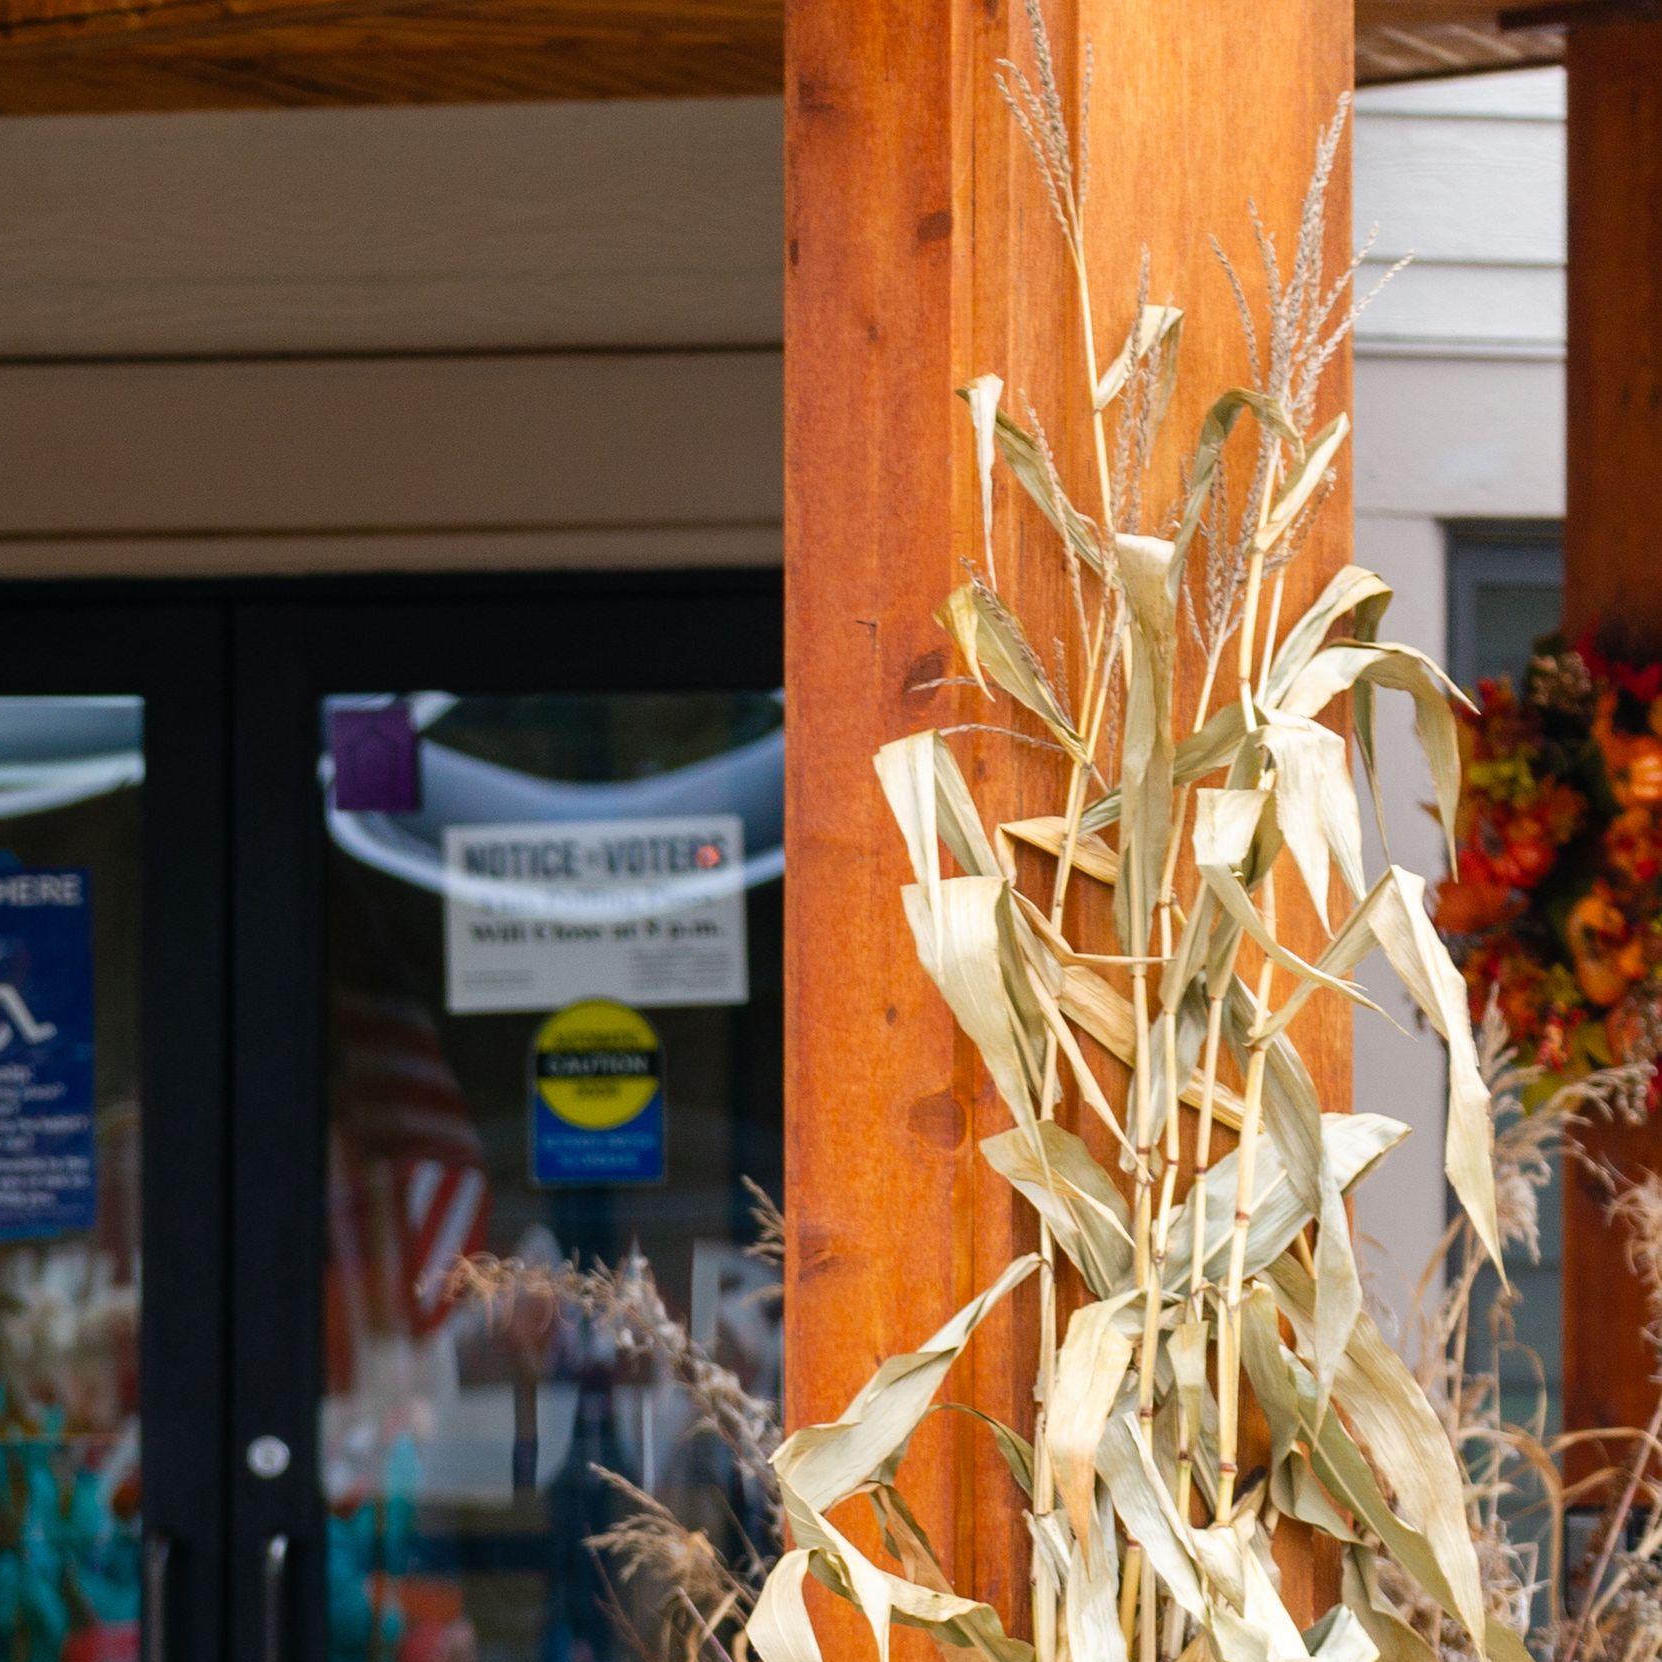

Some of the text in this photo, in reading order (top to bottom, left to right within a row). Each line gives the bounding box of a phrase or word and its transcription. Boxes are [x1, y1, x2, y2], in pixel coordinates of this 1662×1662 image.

[463, 838, 580, 880] NOTICE
[599, 832, 730, 877] VOTERS
[544, 1052, 650, 1075] CAUTION
